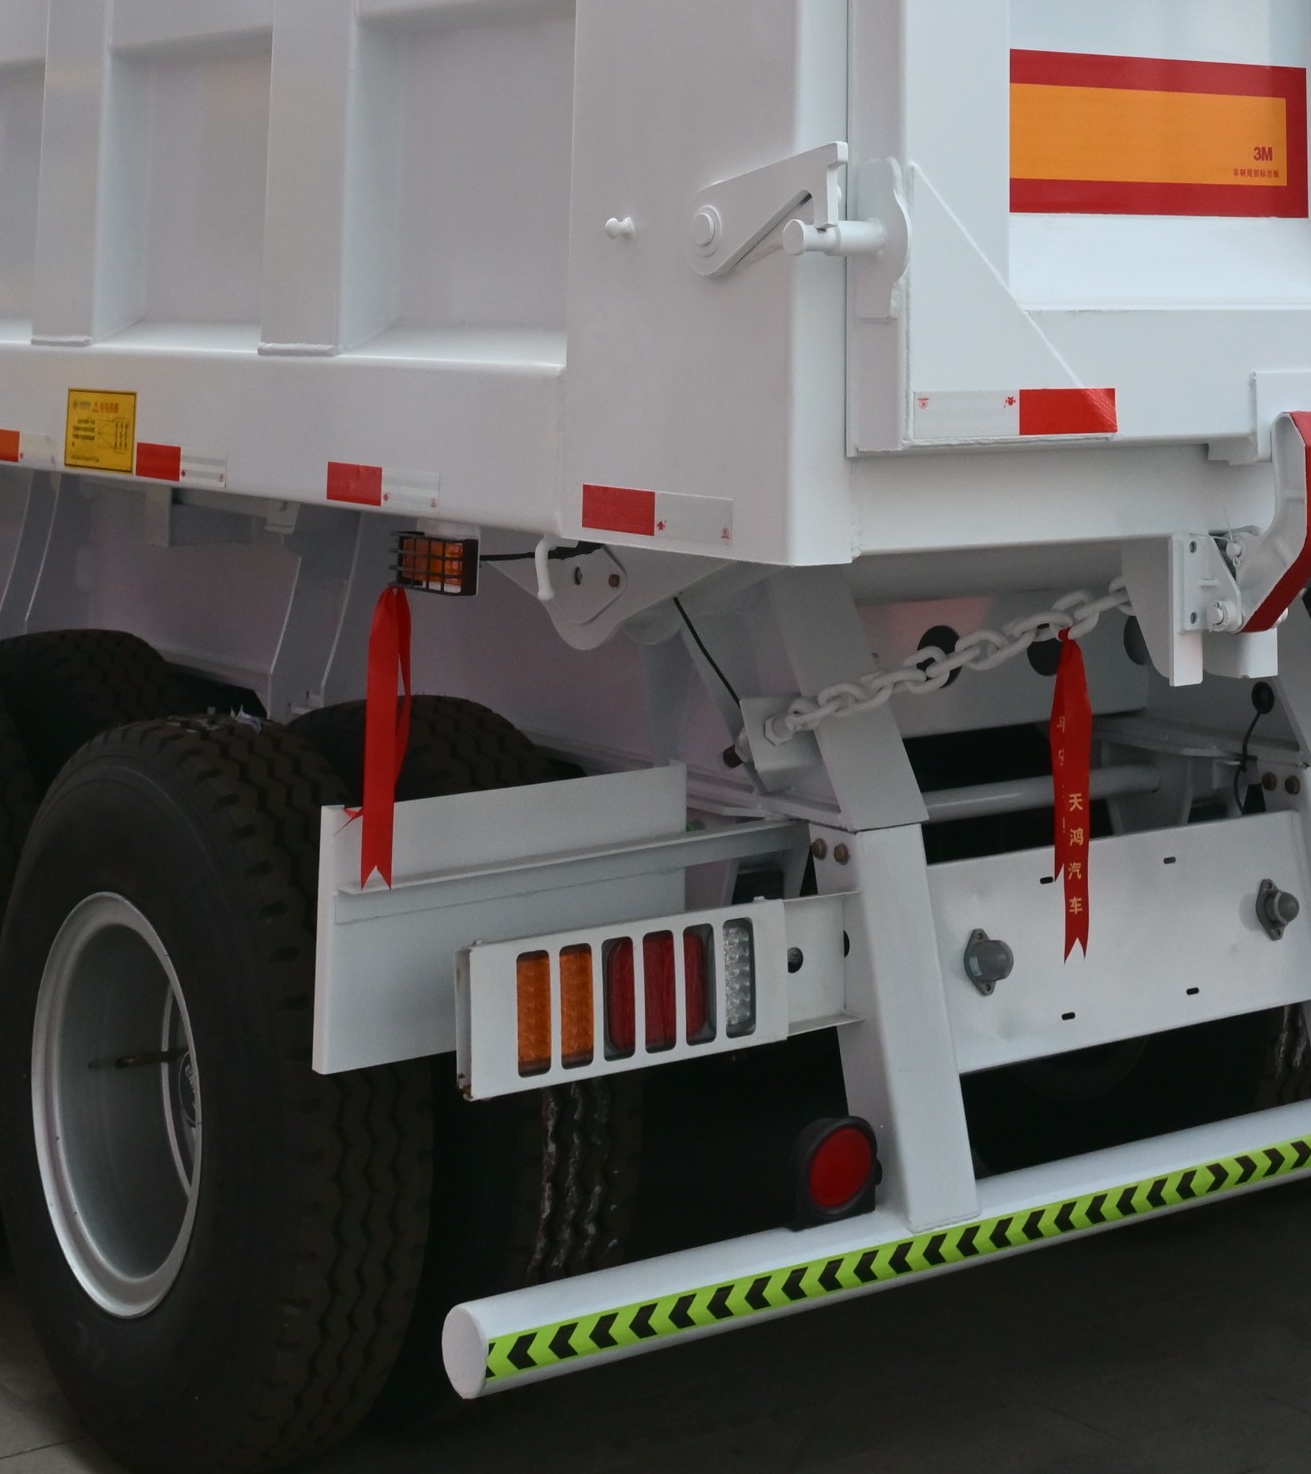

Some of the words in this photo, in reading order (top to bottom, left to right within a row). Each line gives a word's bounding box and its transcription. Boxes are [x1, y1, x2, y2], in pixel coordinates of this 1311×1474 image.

[1253, 146, 1273, 161] 3M
[1068, 792, 1084, 915] 天鸿汽车
